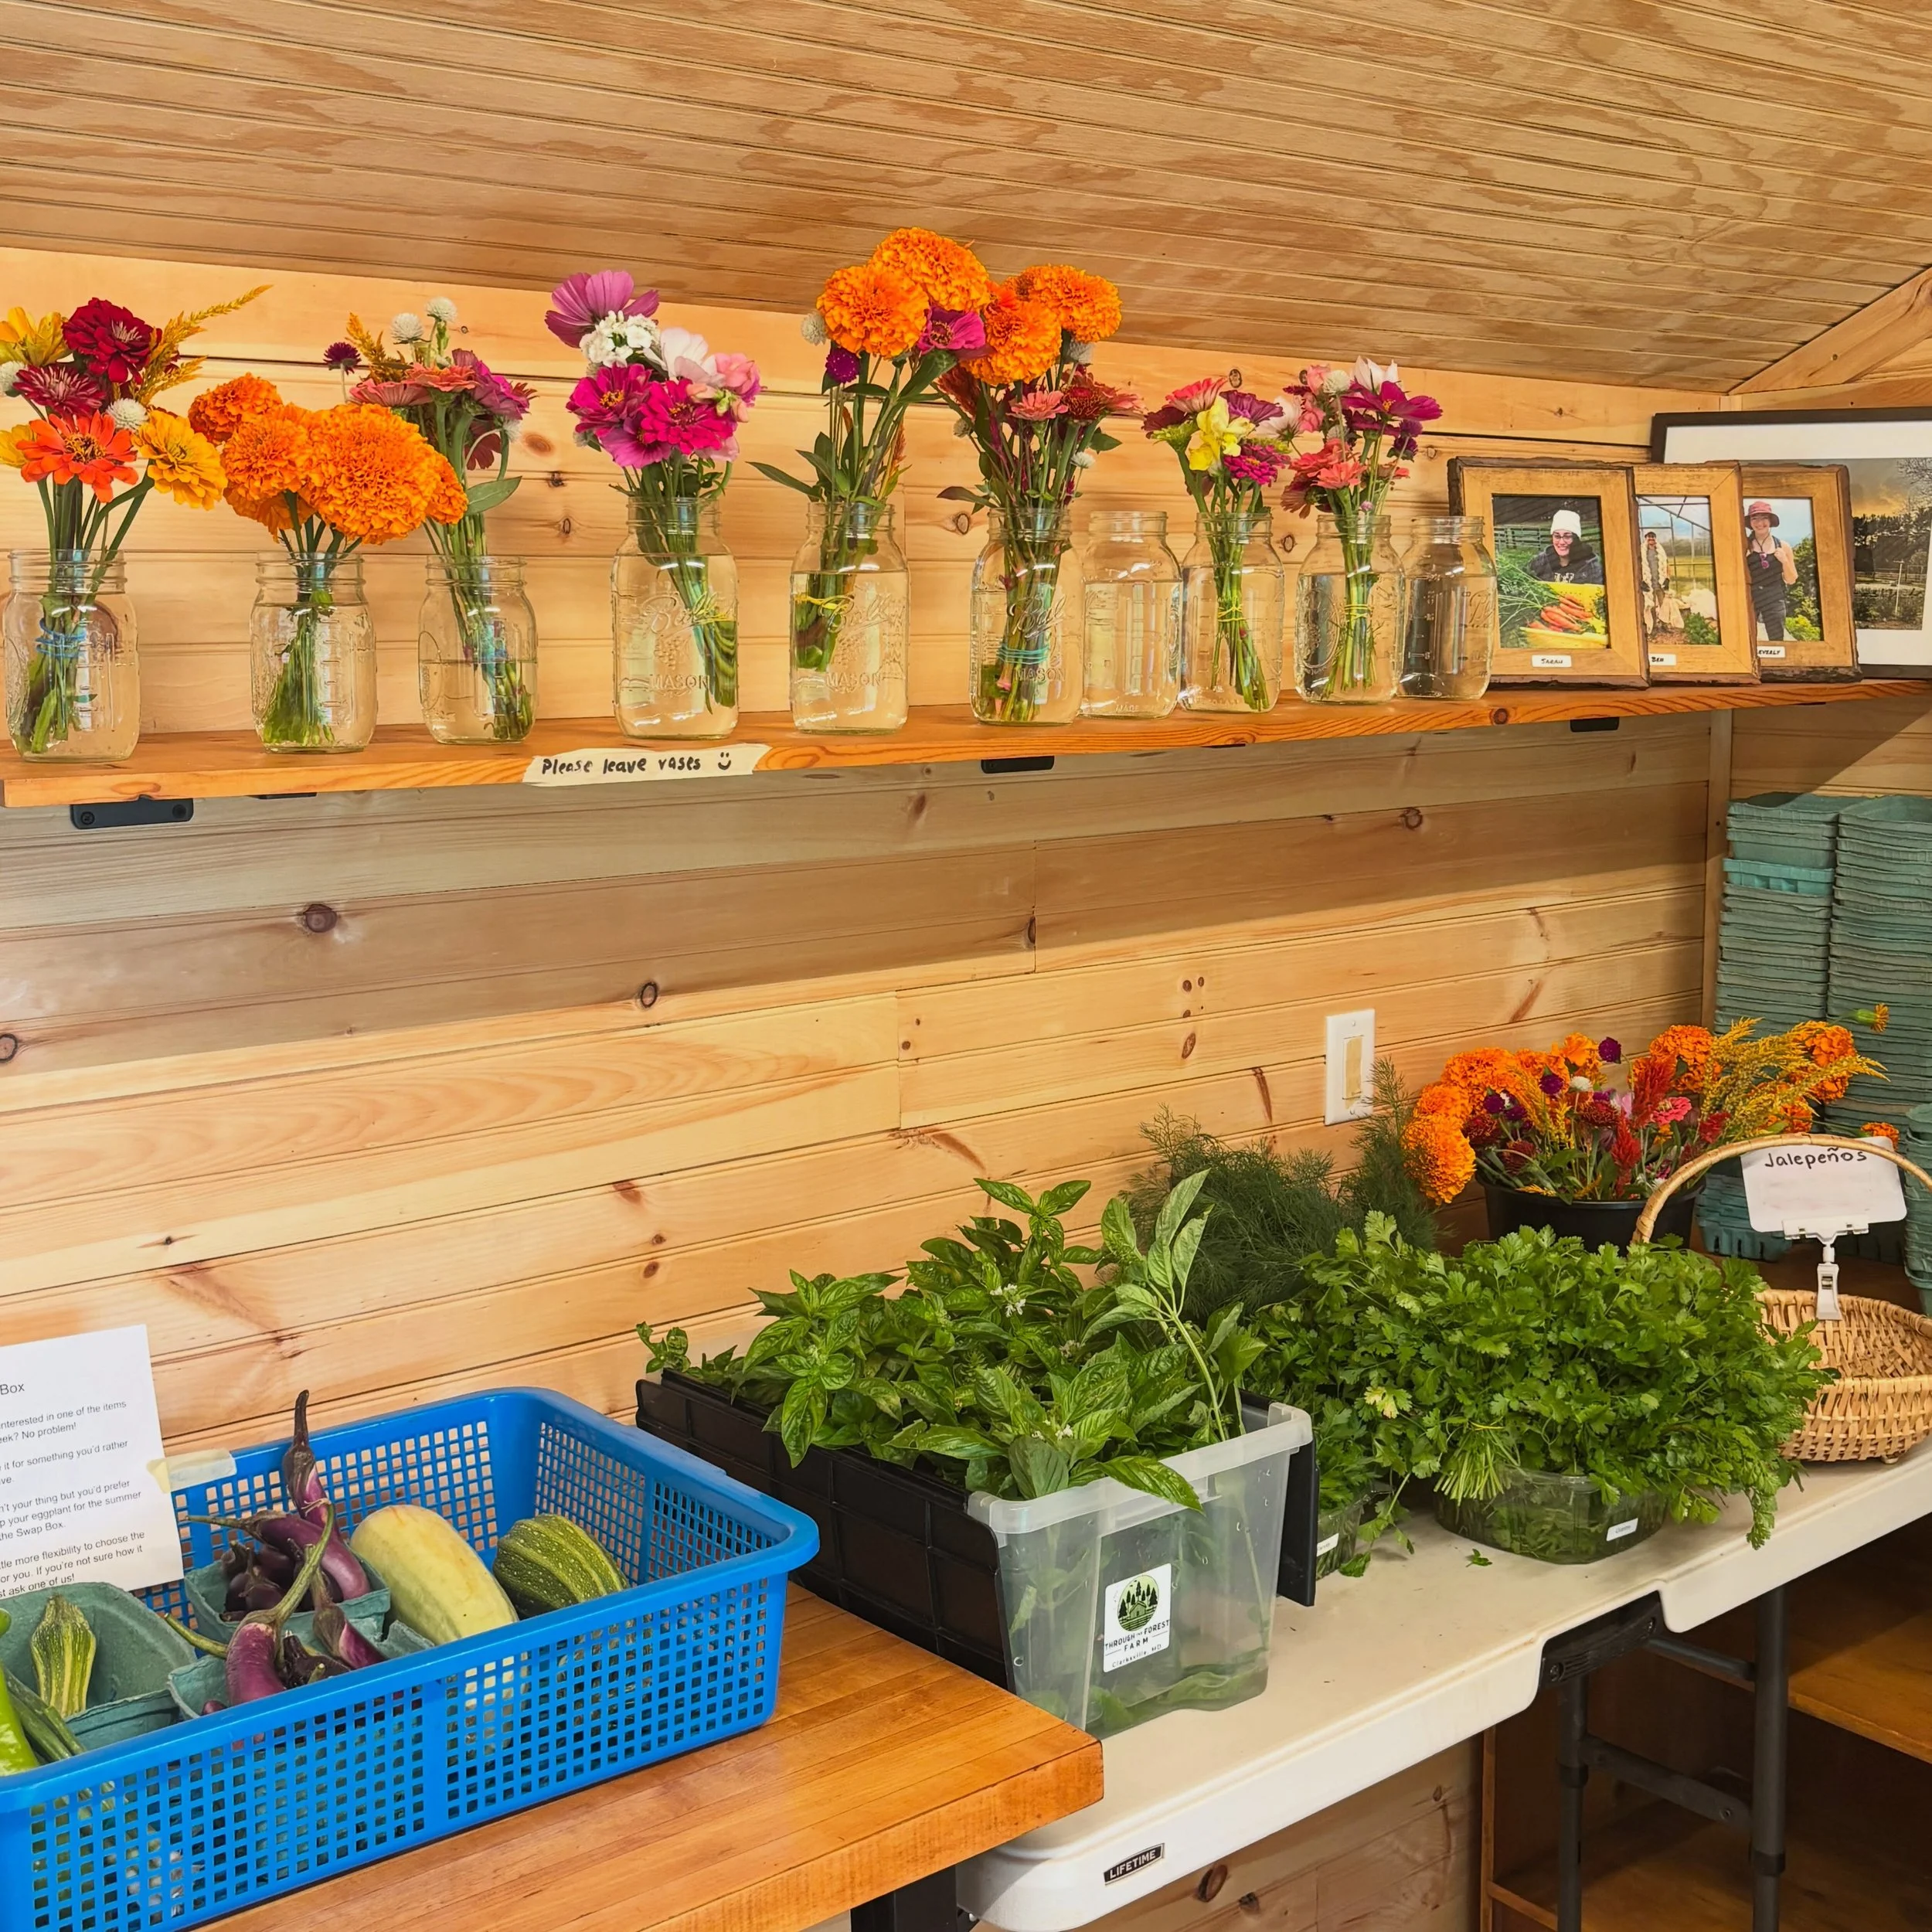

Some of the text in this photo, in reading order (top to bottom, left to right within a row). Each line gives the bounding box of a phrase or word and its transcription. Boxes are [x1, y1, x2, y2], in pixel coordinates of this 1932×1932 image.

[649, 674, 710, 691] MASON
[825, 672, 883, 687] MASON
[542, 755, 702, 775] Please leave vases
[1764, 1147, 1868, 1170] Jalepeños
[0, 1383, 25, 1396] Box
[0, 1401, 127, 1430] nterested in one of the items
[22, 1430, 35, 1440] No
[38, 1421, 77, 1438] problem!
[4, 1440, 128, 1470] it for something you'd rather
[12, 1500, 32, 1512] your
[36, 1495, 58, 1506] thing
[60, 1491, 75, 1501] but
[77, 1485, 102, 1499] you'd
[104, 1480, 130, 1493] prefer
[9, 1515, 29, 1527] your
[32, 1505, 71, 1521] eggplant
[73, 1503, 86, 1512] for
[88, 1499, 102, 1509] the
[105, 1492, 141, 1505] summer
[16, 1526, 43, 1537] Swap
[45, 1522, 66, 1531] Box.
[15, 1554, 39, 1566] more
[42, 1546, 82, 1560] flexibility
[84, 1543, 93, 1551] to
[95, 1536, 128, 1549] choose
[131, 1532, 145, 1541] the
[36, 1566, 43, 1576] If
[45, 1561, 73, 1576] you're
[76, 1556, 90, 1566] not
[93, 1553, 113, 1563] sure
[116, 1547, 134, 1557] how
[137, 1544, 143, 1553] it
[9, 1584, 26, 1596] ask
[28, 1580, 46, 1591] one
[49, 1577, 58, 1587] of
[61, 1573, 75, 1584] us!
[1105, 1633, 1135, 1651] THROUGH
[1144, 1620, 1169, 1635] FOREST
[1124, 1637, 1148, 1652] FARM
[1109, 1849, 1157, 1879] LIFETIME
